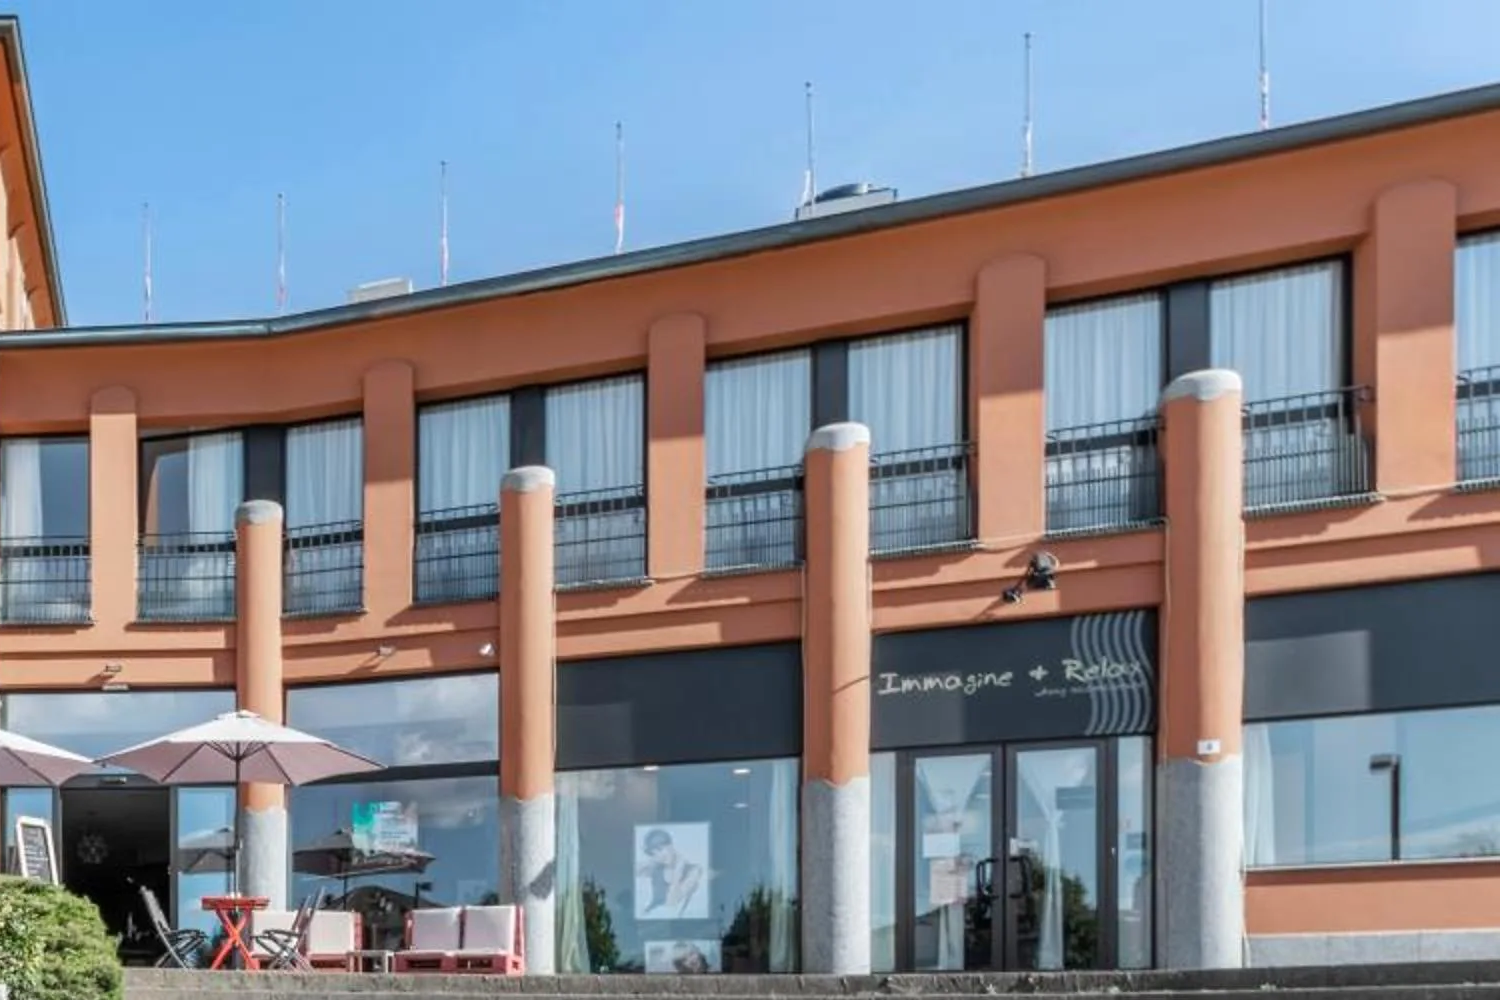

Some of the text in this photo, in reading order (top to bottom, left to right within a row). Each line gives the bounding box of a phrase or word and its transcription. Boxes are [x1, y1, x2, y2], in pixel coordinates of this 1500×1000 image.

[877, 671, 1014, 695] Immagine
[1028, 664, 1049, 681] +
[1062, 656, 1141, 684] Relax
